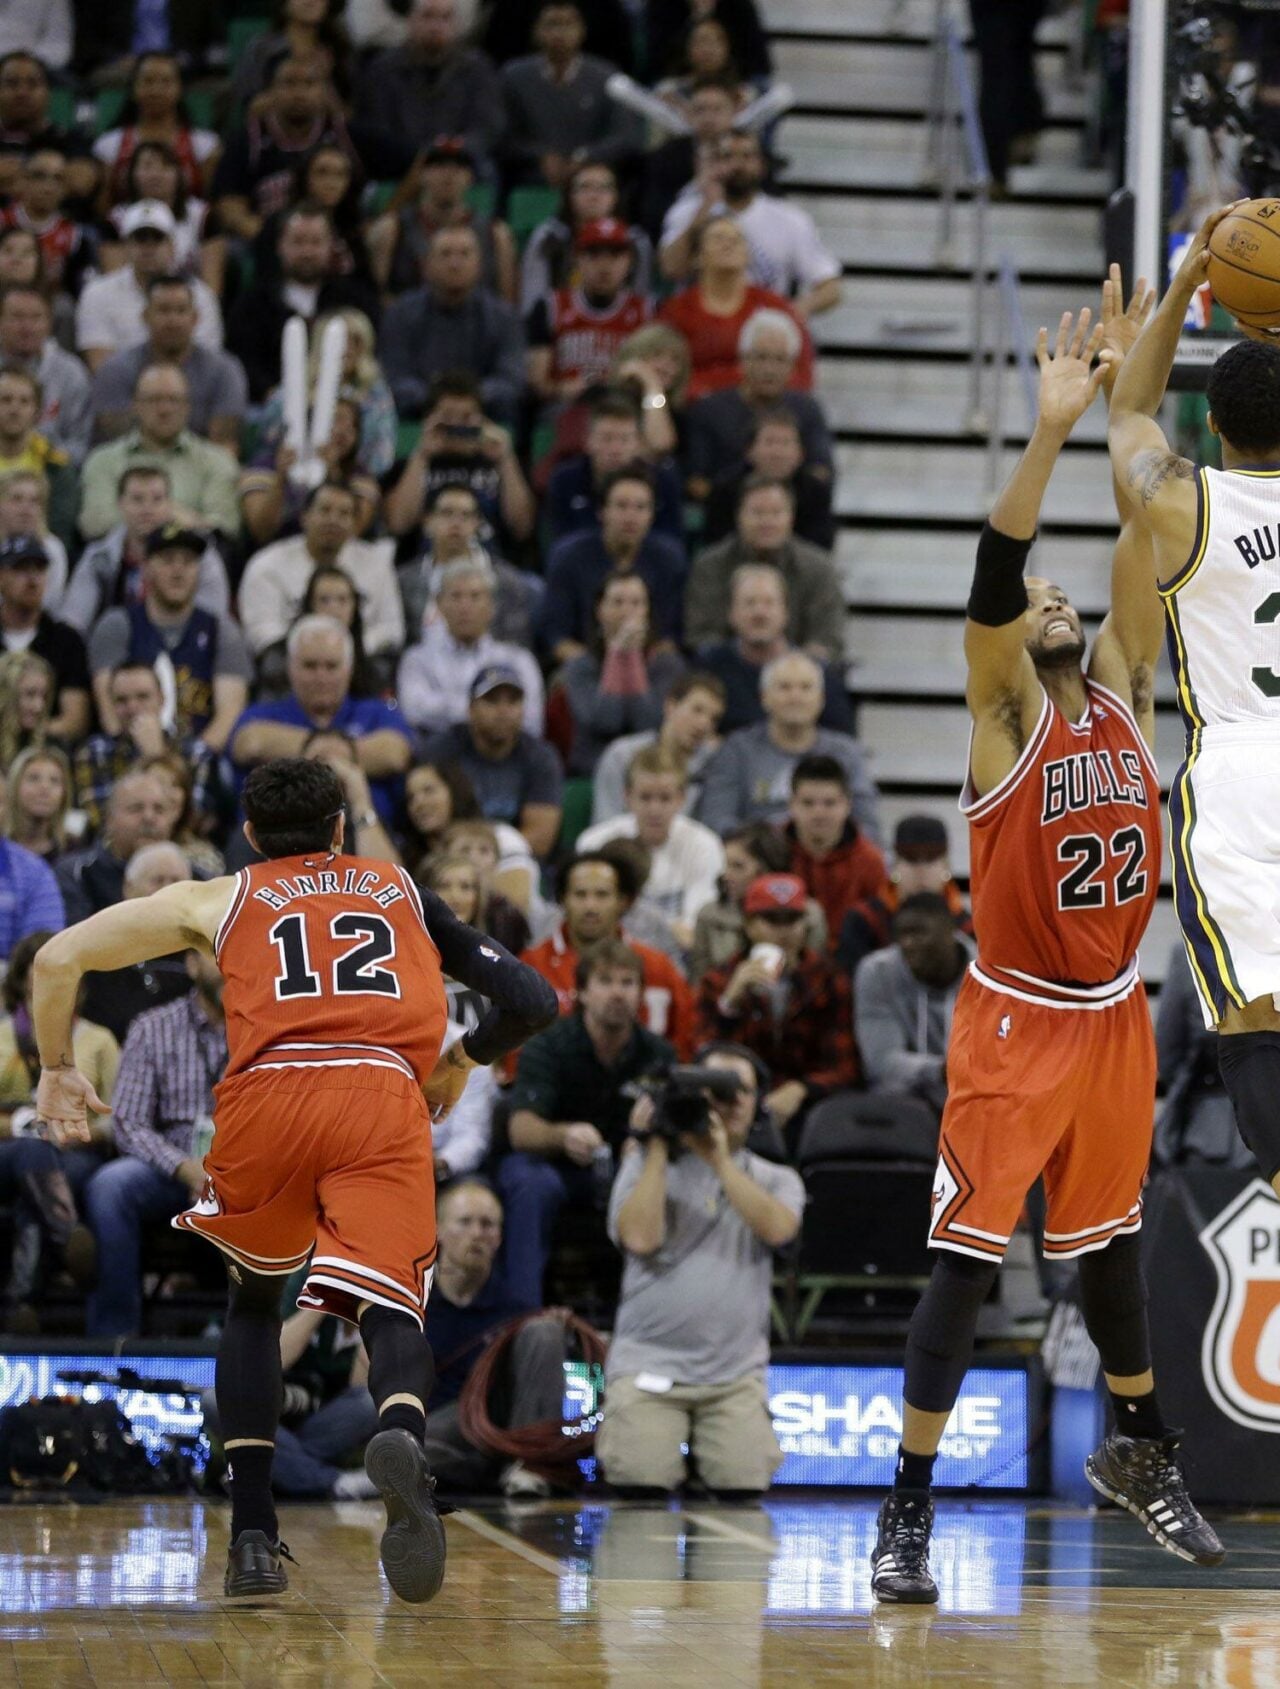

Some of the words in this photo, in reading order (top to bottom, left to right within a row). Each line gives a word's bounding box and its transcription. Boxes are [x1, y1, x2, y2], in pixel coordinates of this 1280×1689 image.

[1041, 750, 1148, 826] BULLS
[253, 868, 404, 911] HINRICH
[1057, 823, 1147, 912] 22
[269, 911, 401, 1001] 12
